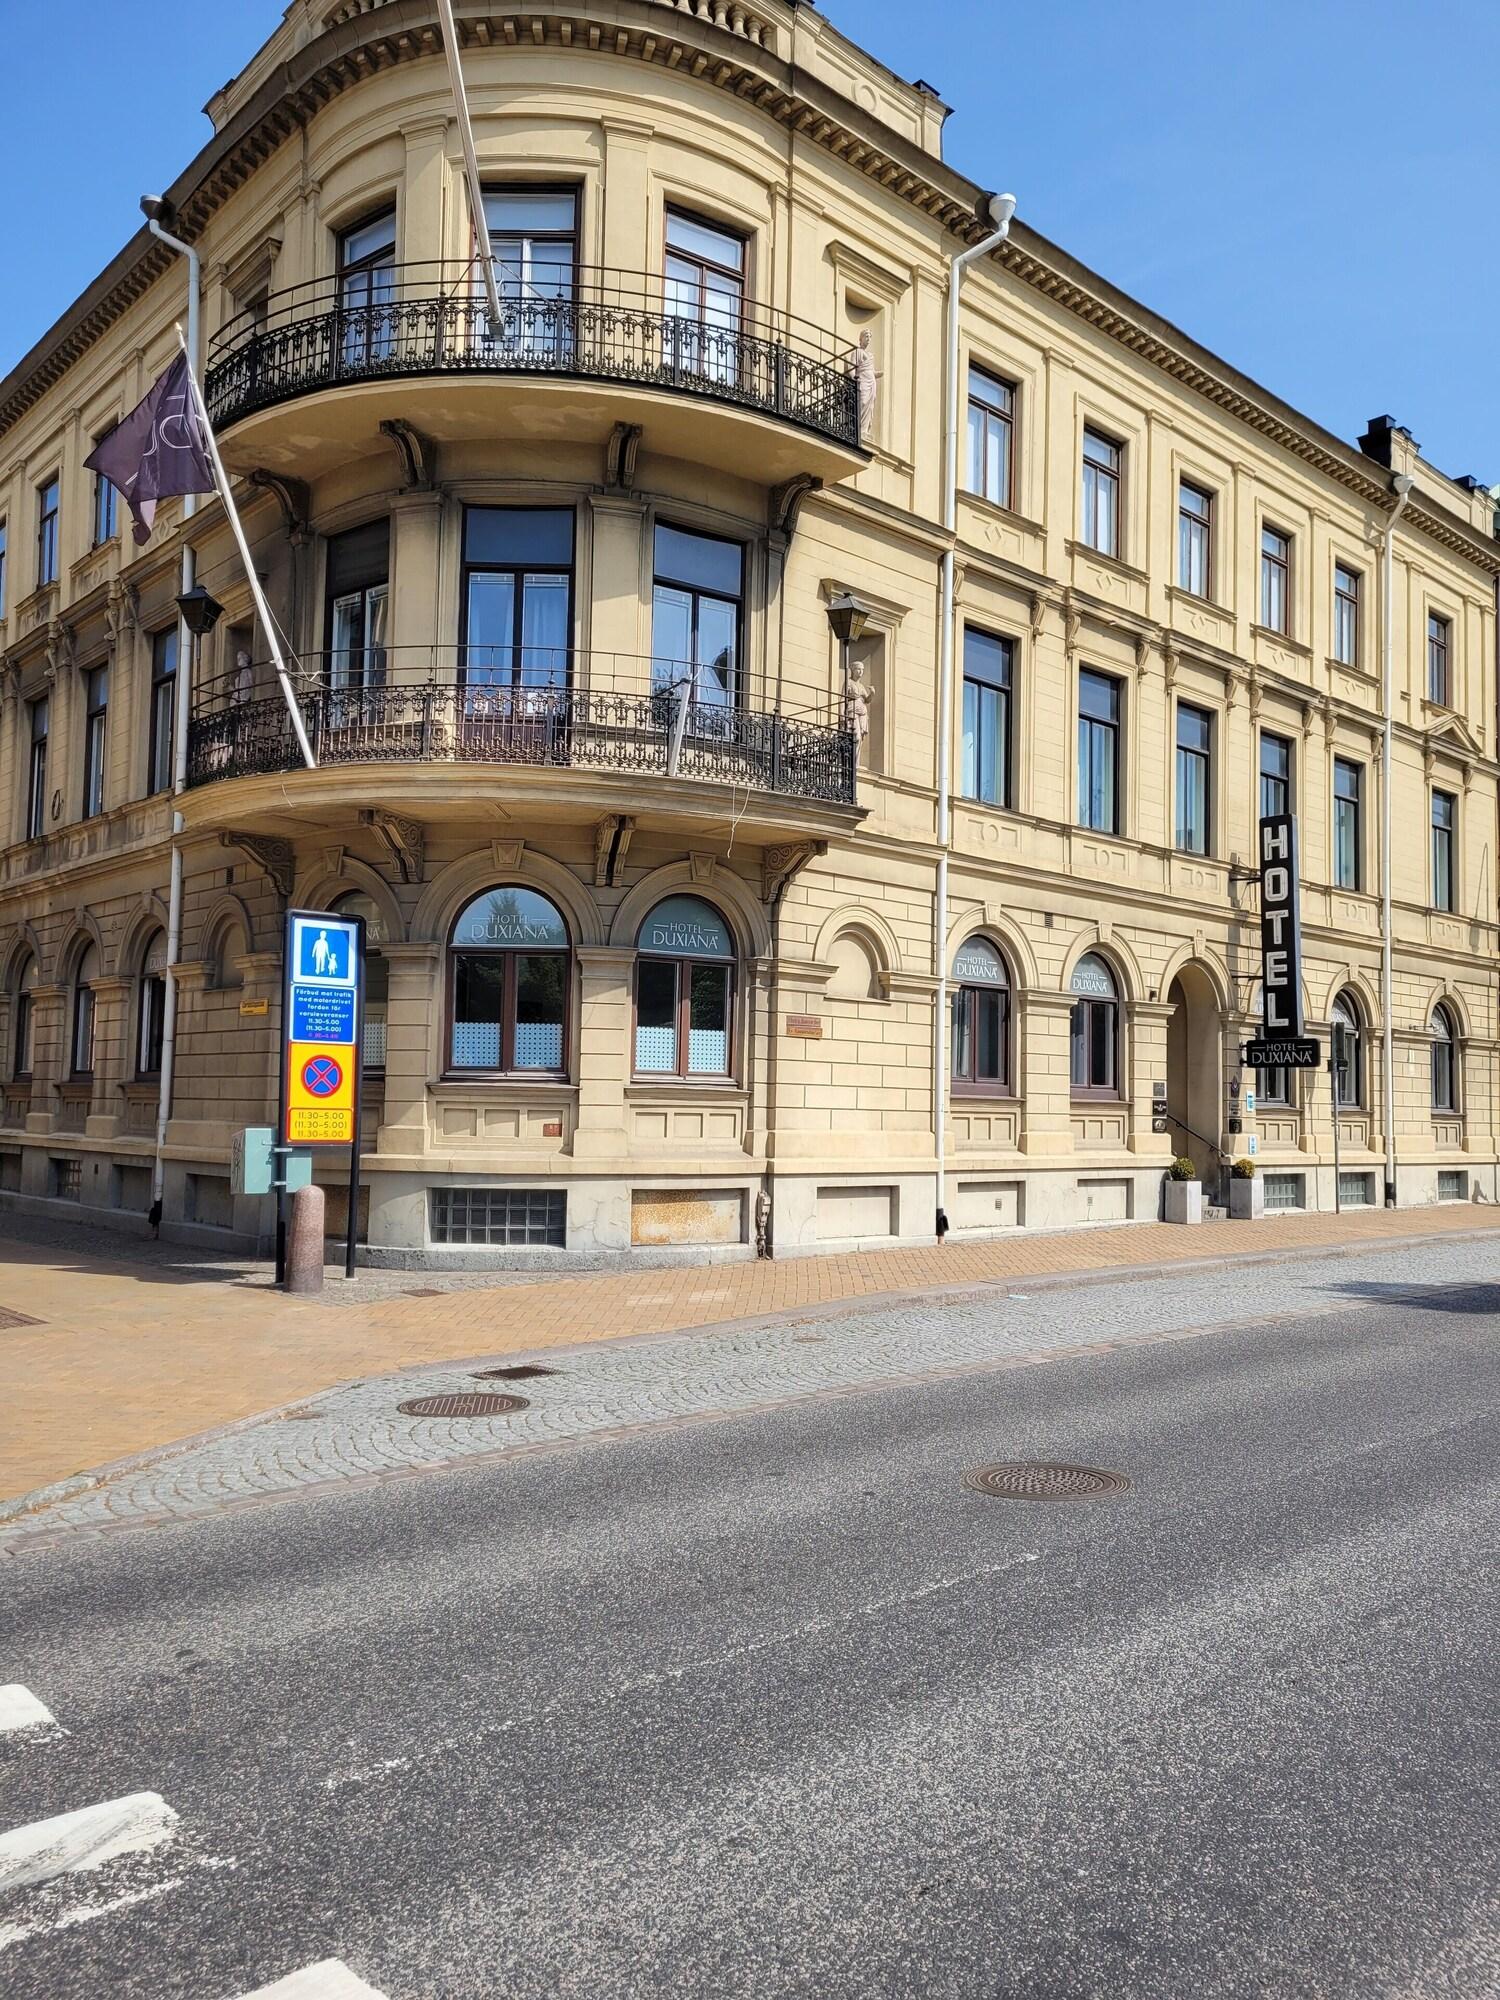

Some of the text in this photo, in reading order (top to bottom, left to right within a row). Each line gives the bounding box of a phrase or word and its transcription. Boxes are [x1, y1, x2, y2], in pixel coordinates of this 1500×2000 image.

[471, 924, 549, 939] DUXIANA
[670, 922, 702, 934] HOTEL
[1263, 824, 1290, 1028] HOTEL
[966, 956, 987, 966] HOTEL
[1081, 972, 1099, 981] HOTEL
[1266, 1043, 1297, 1052] HOTEL
